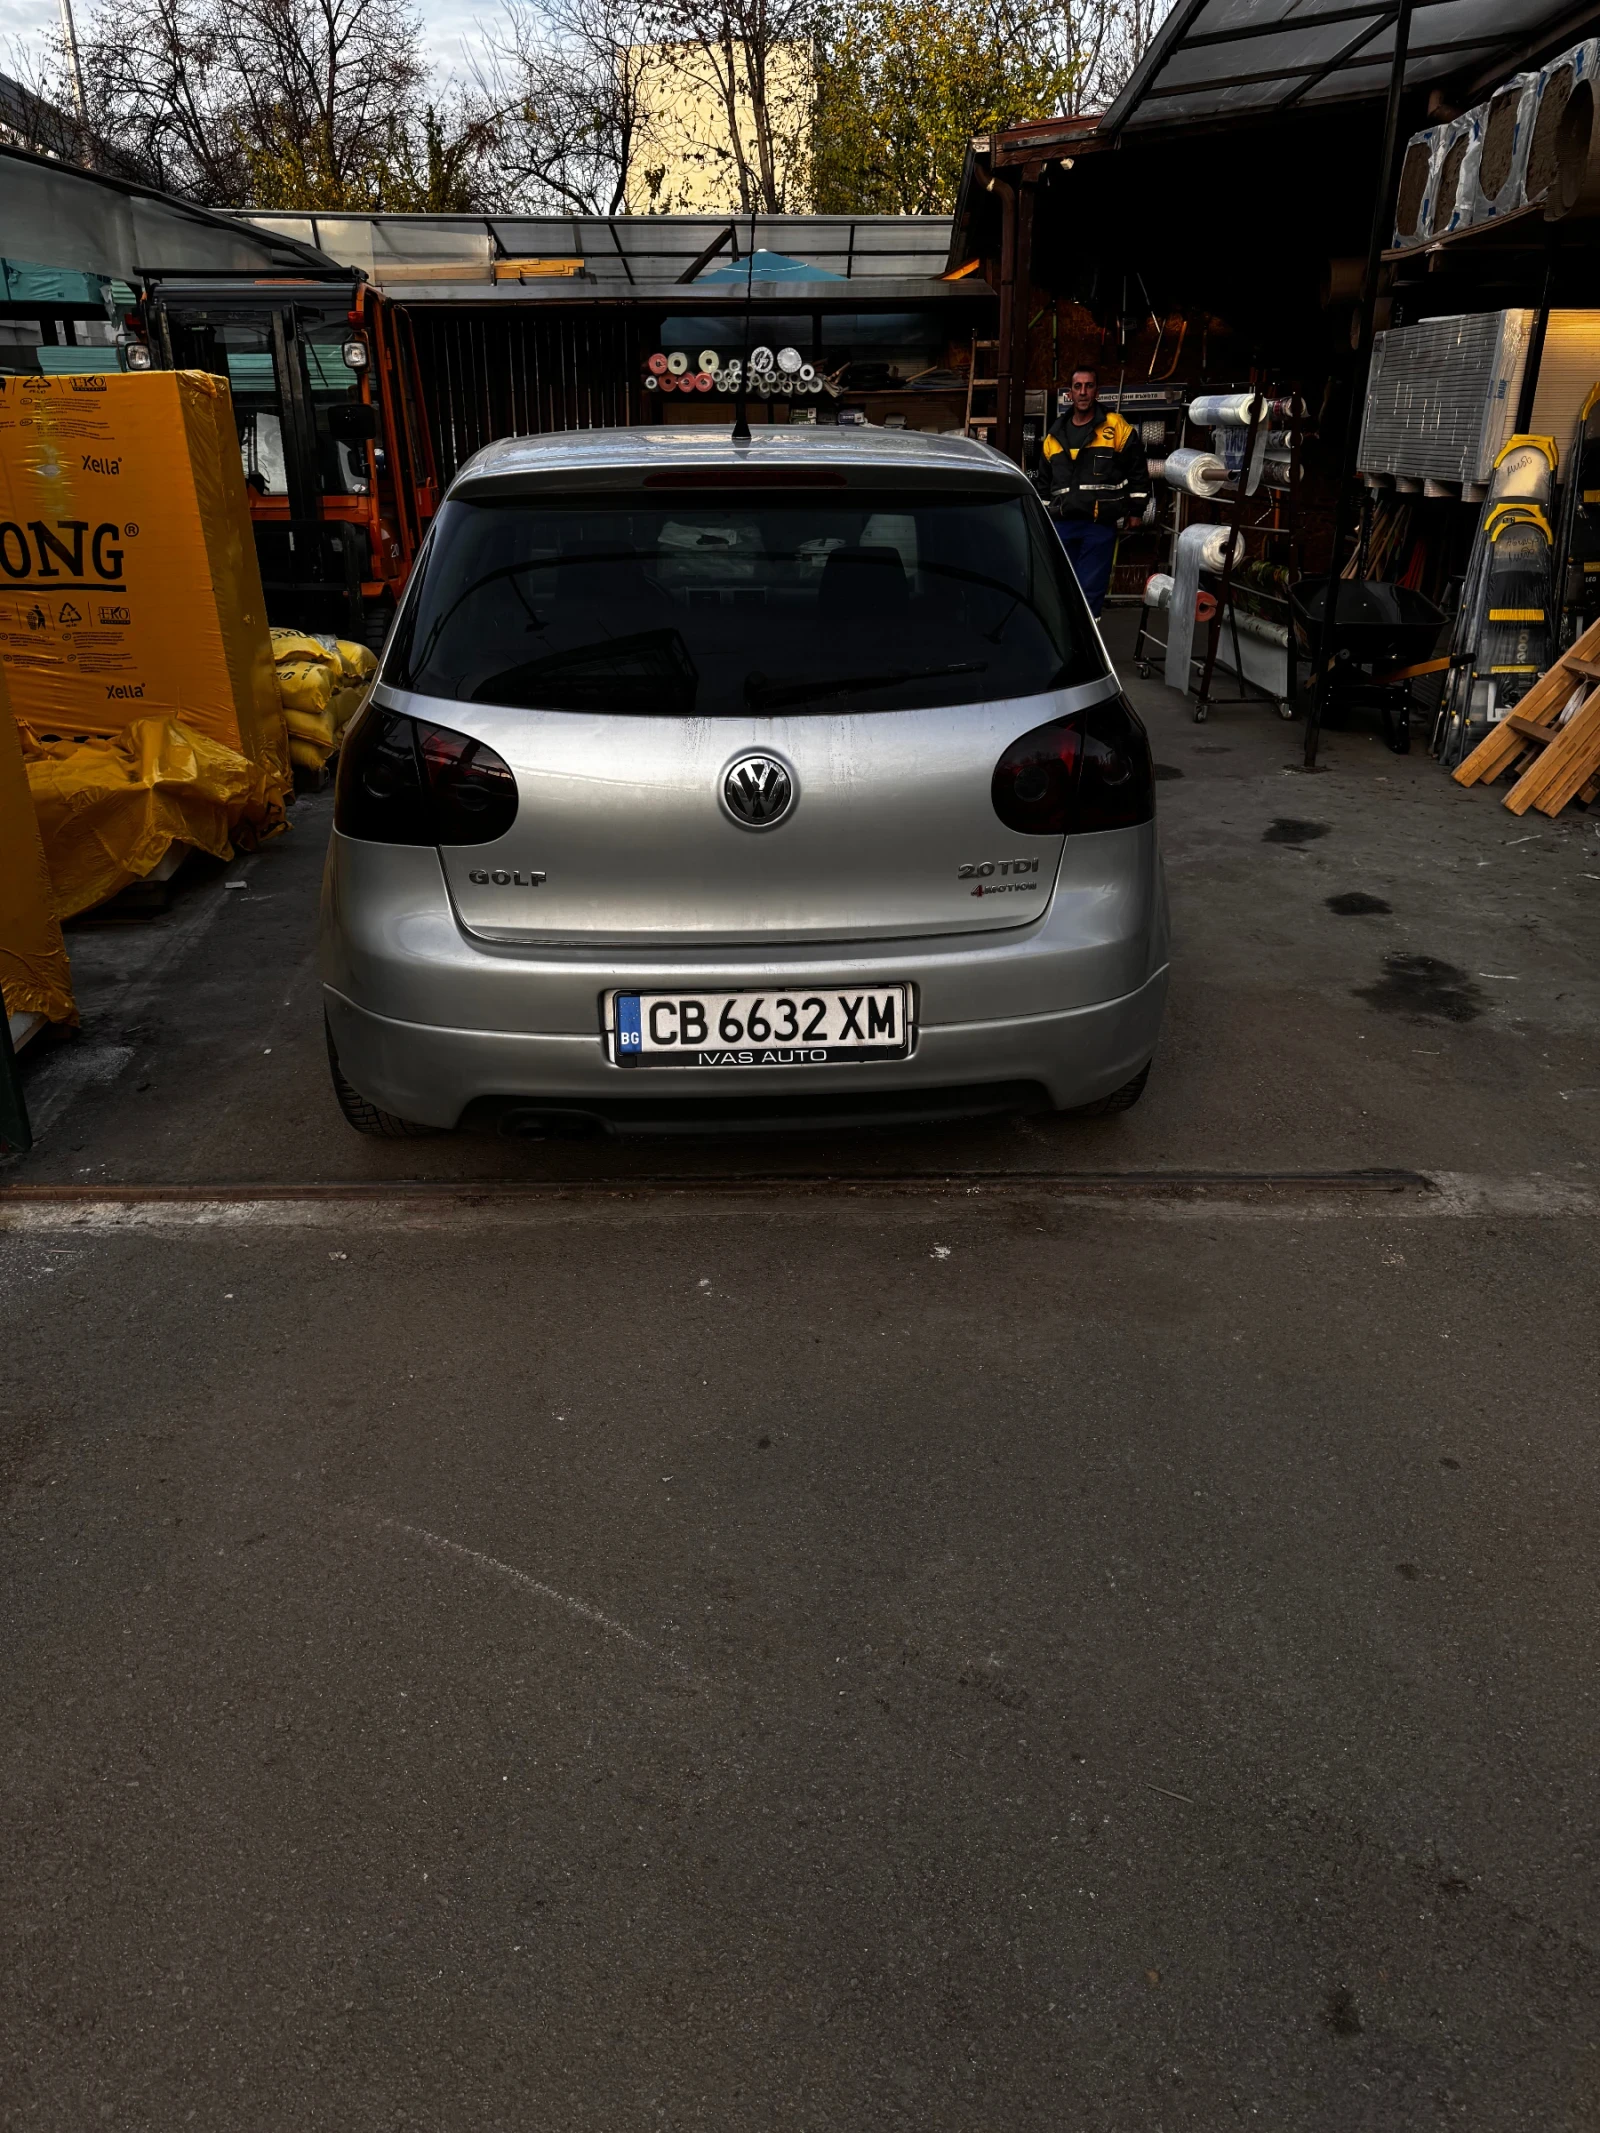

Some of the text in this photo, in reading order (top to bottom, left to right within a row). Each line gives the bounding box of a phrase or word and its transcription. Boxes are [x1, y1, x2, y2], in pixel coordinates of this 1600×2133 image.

[998, 857, 1039, 876] TDI
[468, 869, 547, 887] GOLF
[649, 996, 896, 1045] CB 6632 XM
[620, 1031, 640, 1046] BG
[698, 1049, 828, 1065] IVAS AUTO
